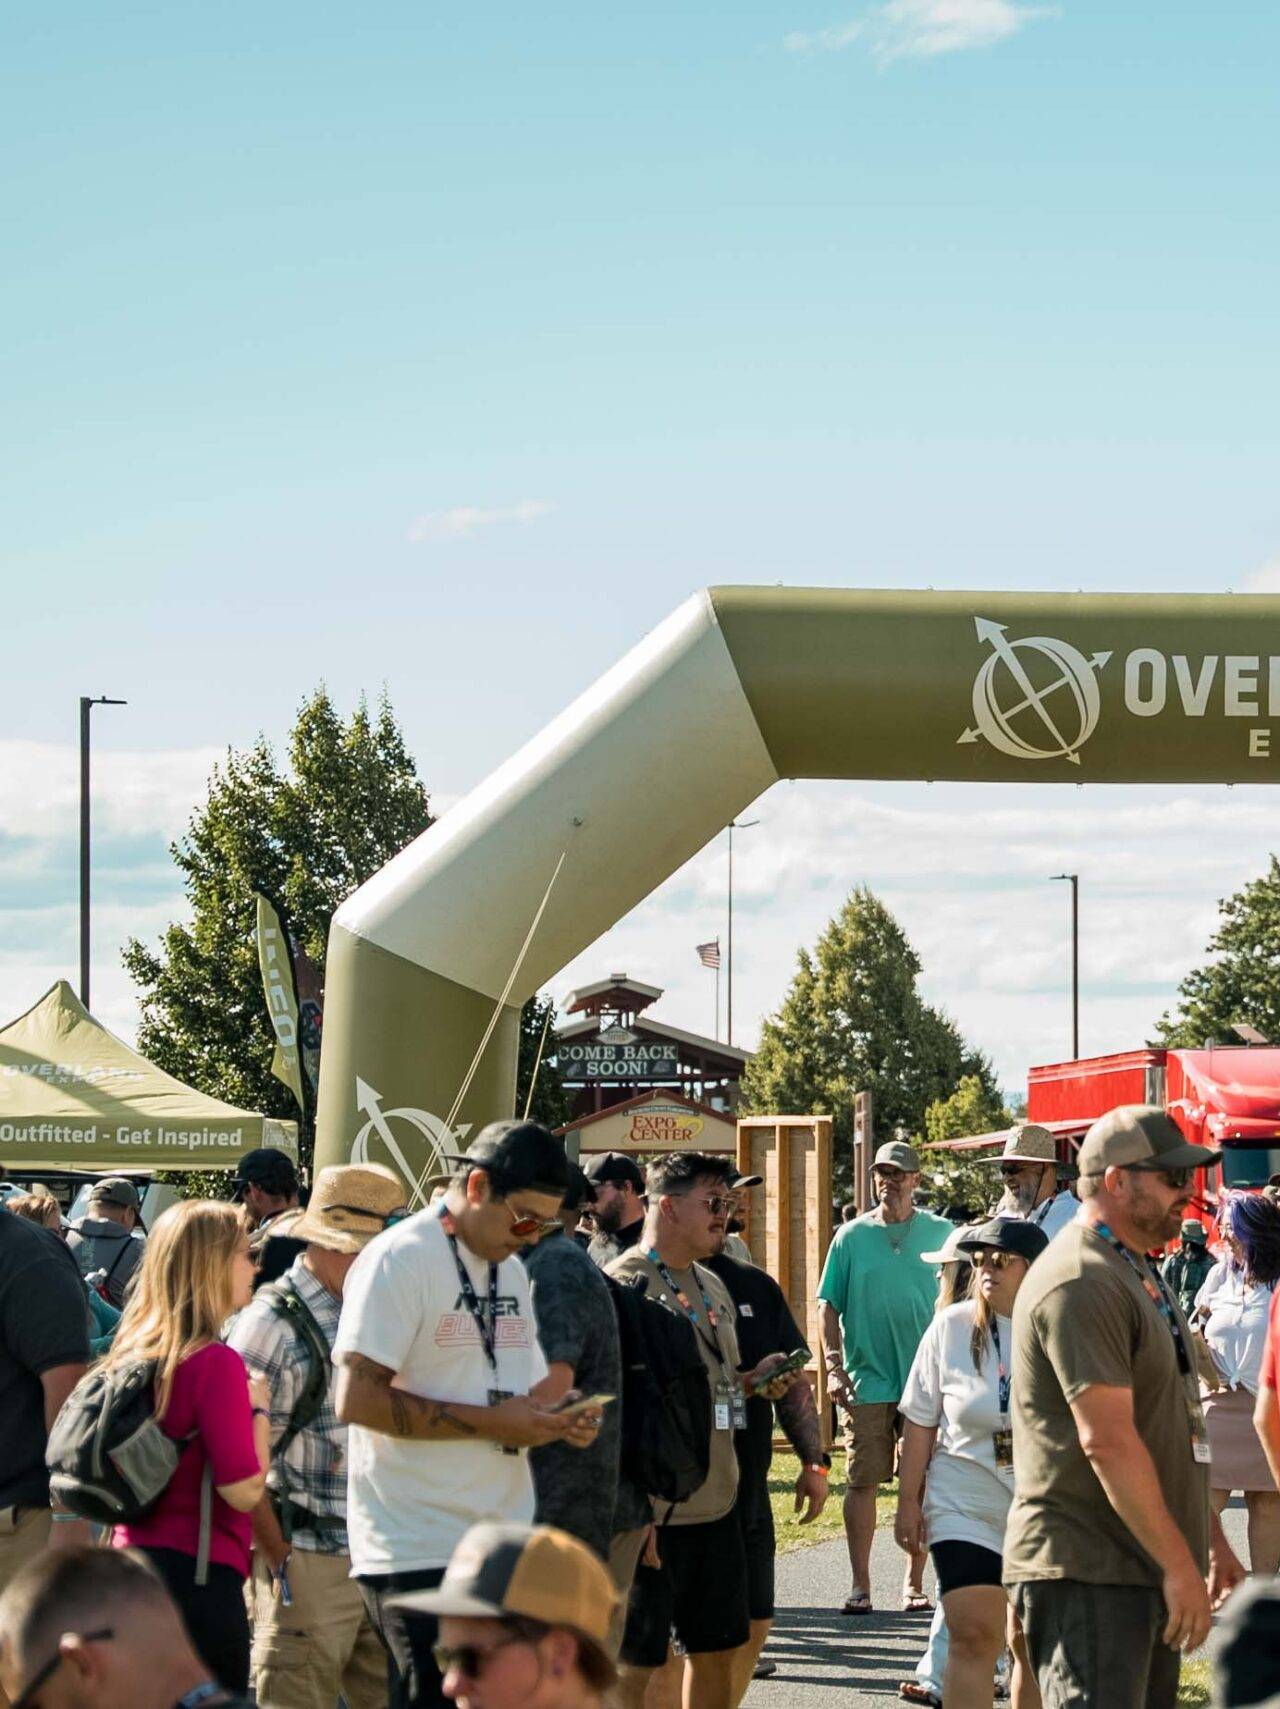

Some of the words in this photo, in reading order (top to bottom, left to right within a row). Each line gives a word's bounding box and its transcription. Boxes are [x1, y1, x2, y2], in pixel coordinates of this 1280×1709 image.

[558, 1045, 616, 1061] COME
[623, 1045, 678, 1060] BACK
[586, 1061, 648, 1076] SOON!
[632, 1116, 676, 1129] EXPO
[0, 1123, 97, 1144] Outfitted
[116, 1126, 152, 1145] Get
[157, 1127, 242, 1150] Inspired
[630, 1128, 693, 1142] CENTER
